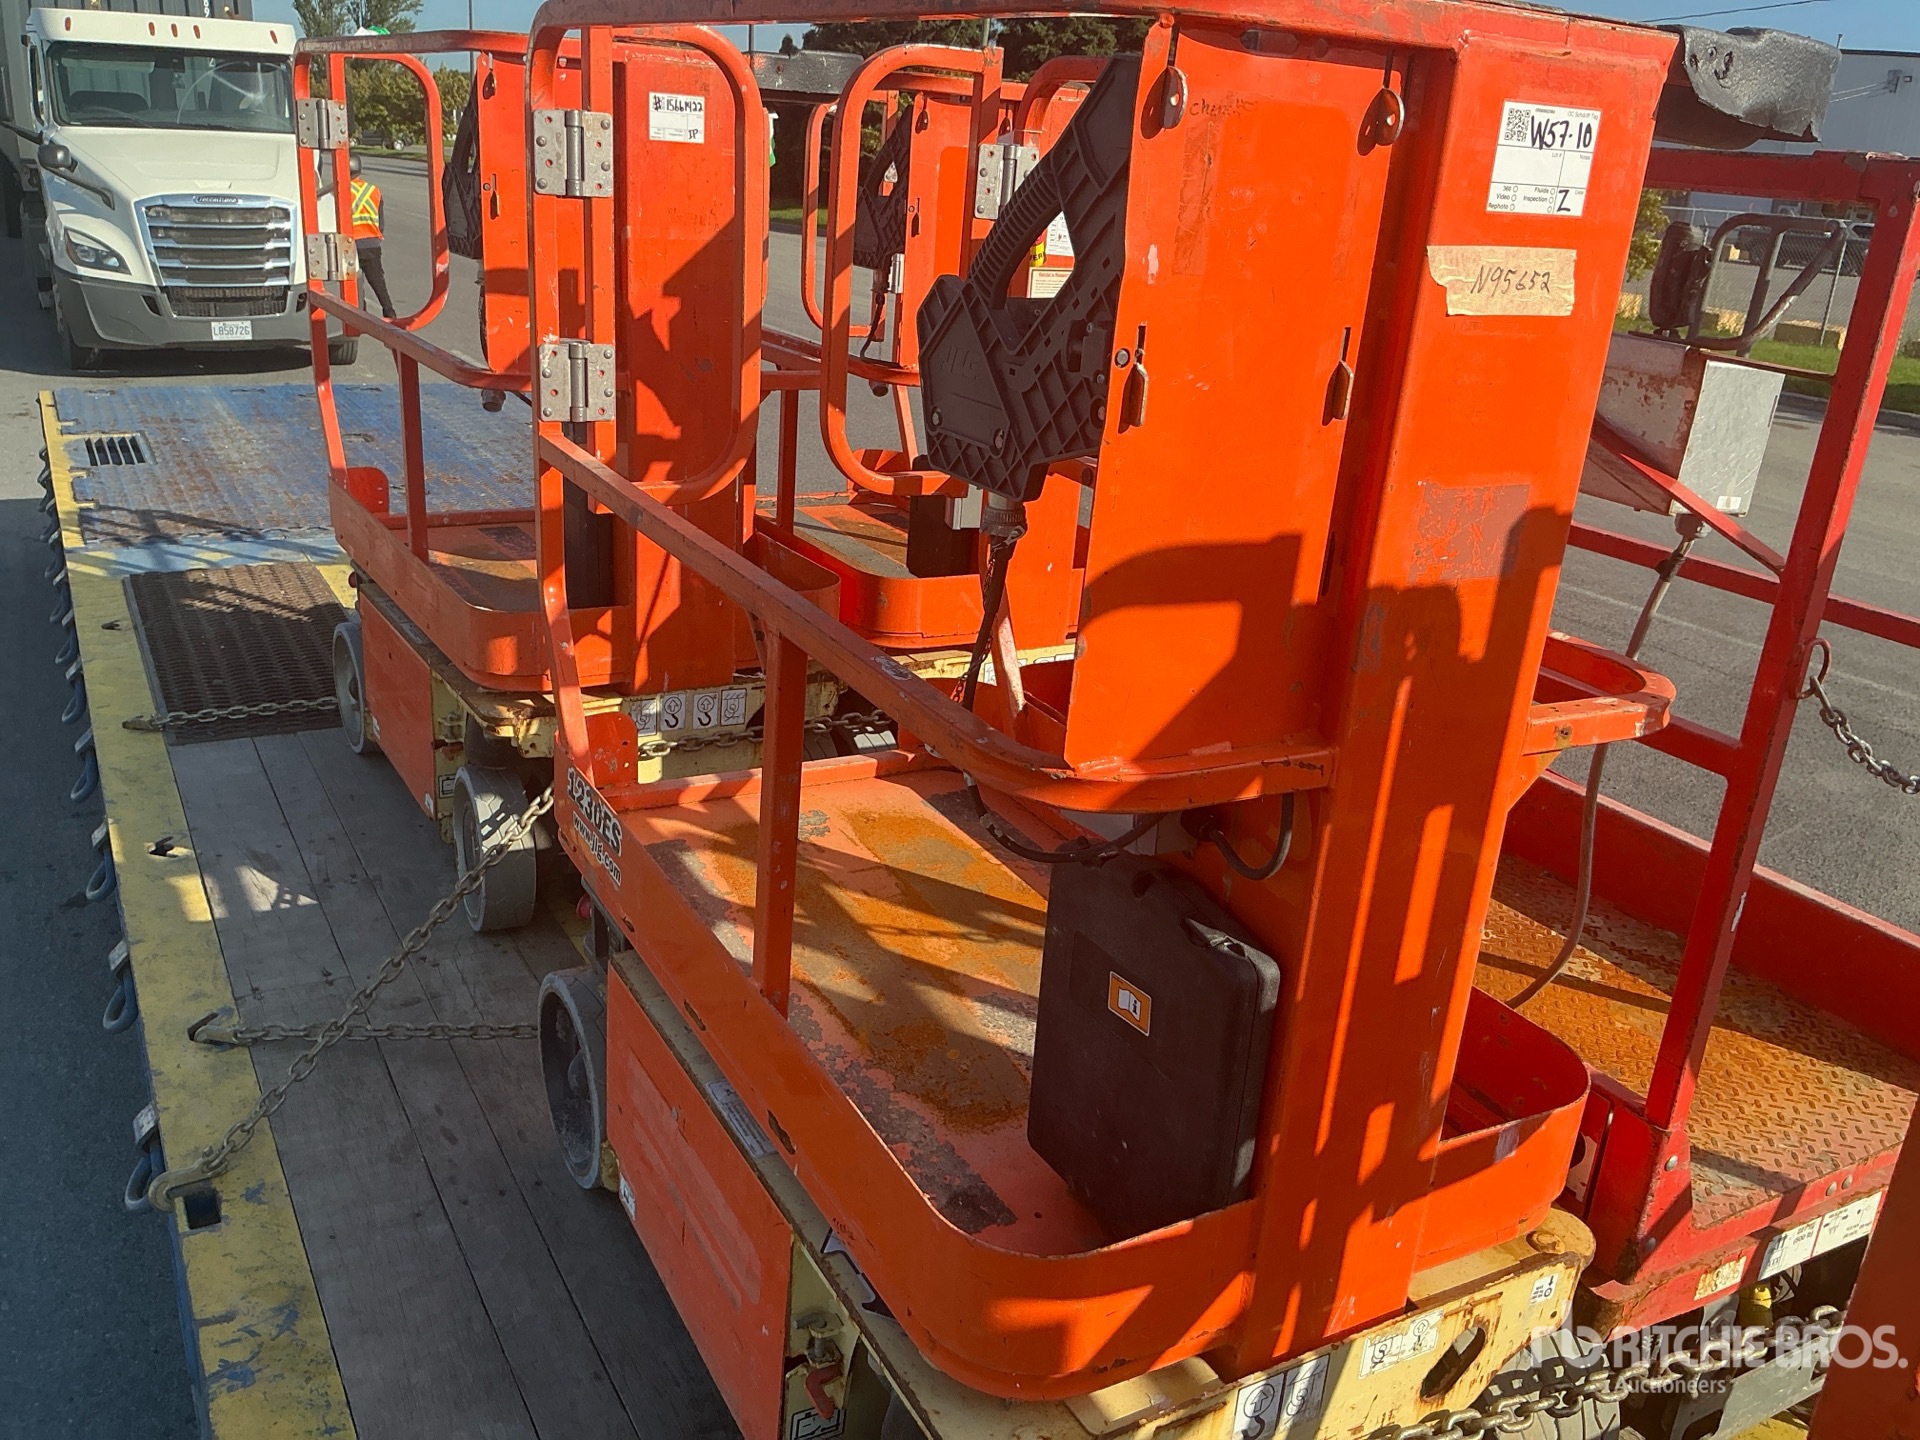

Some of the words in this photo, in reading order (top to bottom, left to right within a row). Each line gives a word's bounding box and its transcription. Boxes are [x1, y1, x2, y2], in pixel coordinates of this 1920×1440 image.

[1488, 202, 1509, 210] Rephoto
[1523, 195, 1548, 203] Inspection
[1470, 265, 1550, 297] N95652
[567, 767, 622, 857] 1230ES
[573, 810, 621, 886] www.jlg.com
